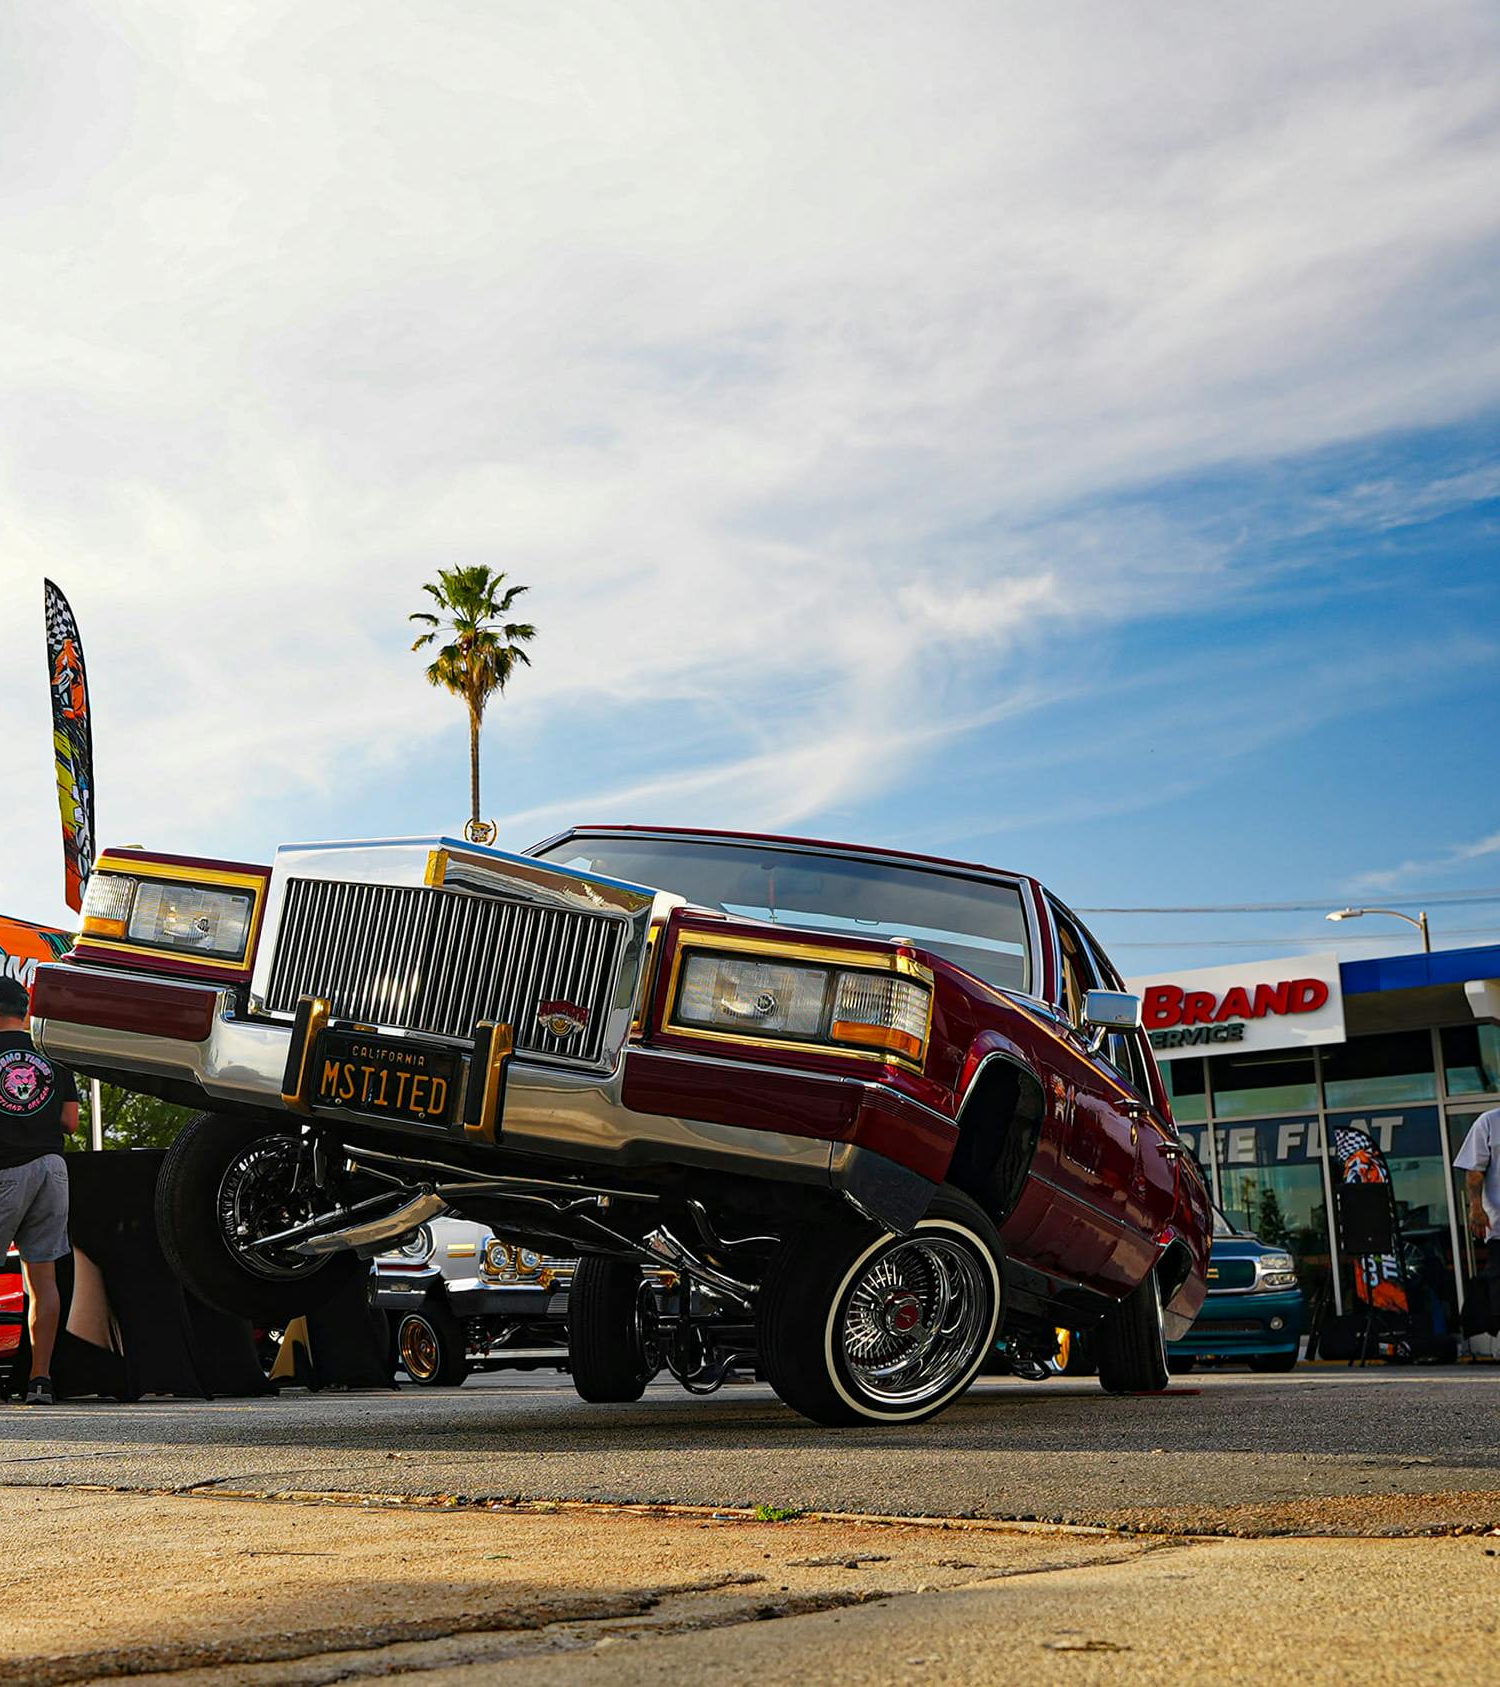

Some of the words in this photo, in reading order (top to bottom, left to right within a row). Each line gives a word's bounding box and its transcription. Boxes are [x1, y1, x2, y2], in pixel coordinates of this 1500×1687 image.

[1141, 978, 1330, 1030] BRAND
[351, 1045, 426, 1067] CALIFORNIA
[1148, 1023, 1245, 1049] ERVICE
[320, 1059, 448, 1115] MST1TED
[1276, 1115, 1404, 1161] FLT
